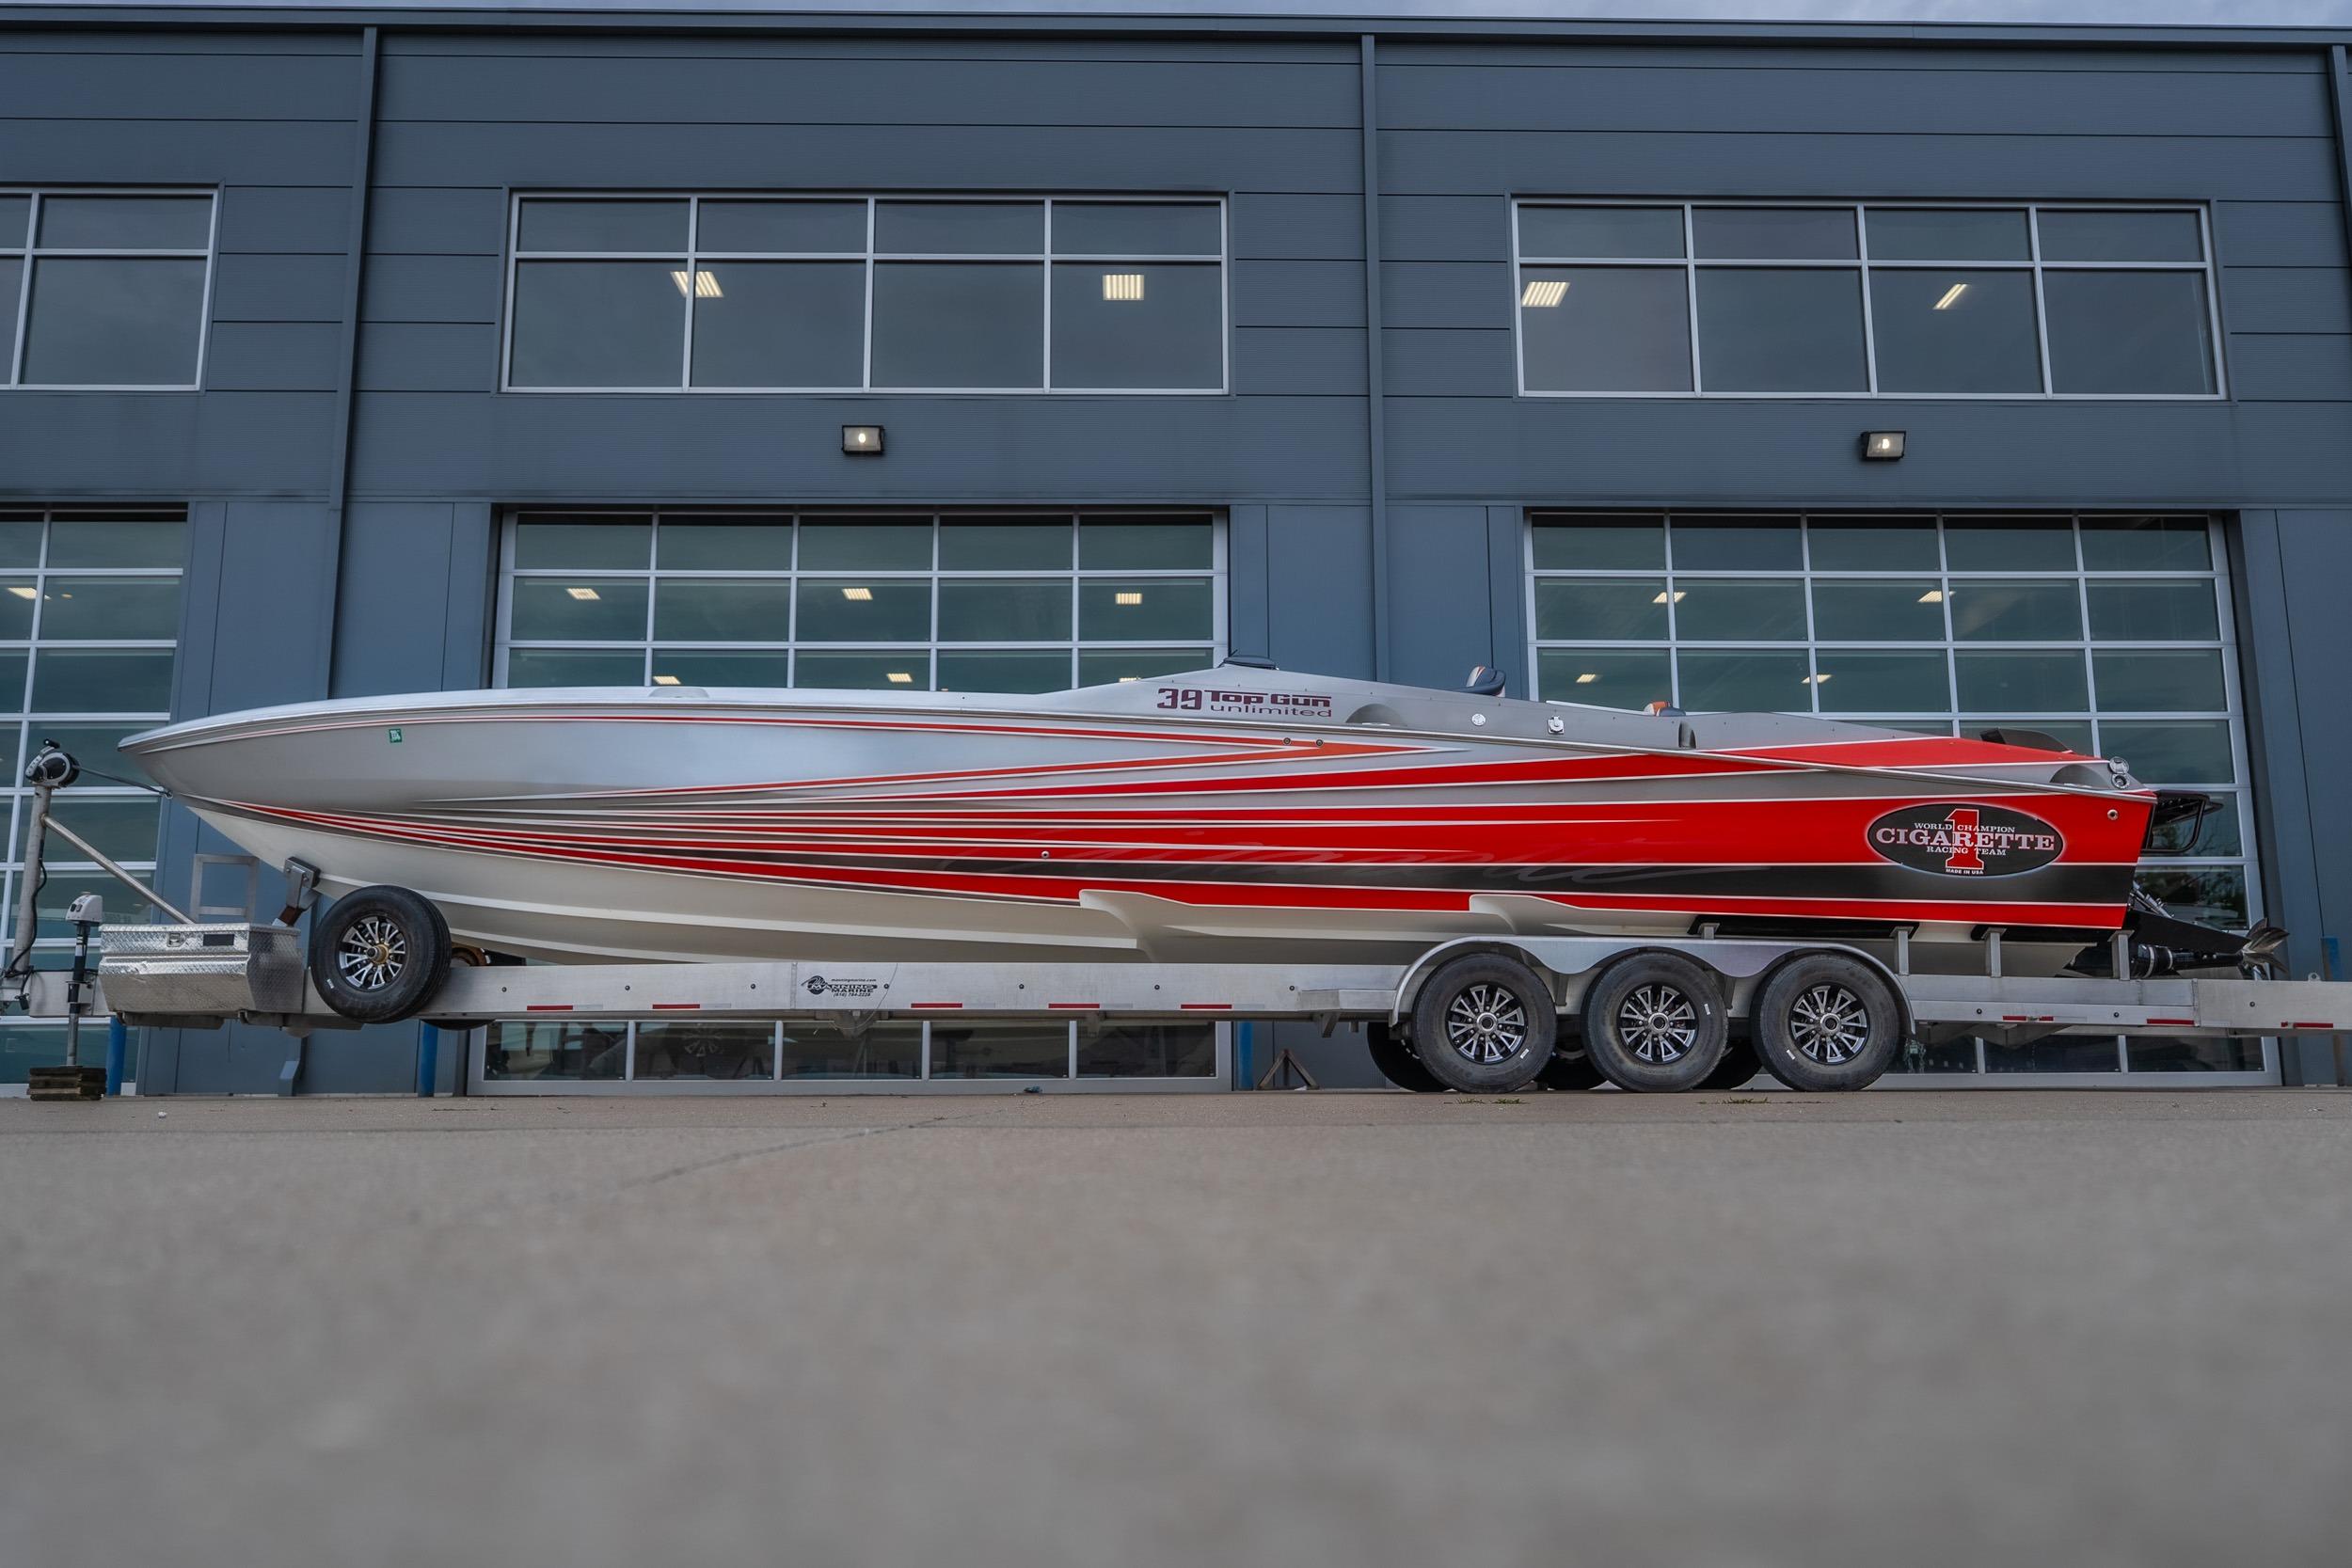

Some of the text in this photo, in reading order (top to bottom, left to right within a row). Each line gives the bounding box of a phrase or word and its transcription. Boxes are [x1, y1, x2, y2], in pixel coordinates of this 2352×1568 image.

[1156, 688, 1332, 710] 39 Top Gun
[1210, 704, 1332, 718] unlimited
[1914, 822, 2016, 833] WORLD CHAMPION
[1875, 827, 2055, 851] CIGARETTE
[1944, 808, 1985, 870] 1
[1926, 846, 2007, 856] RACING TEAM
